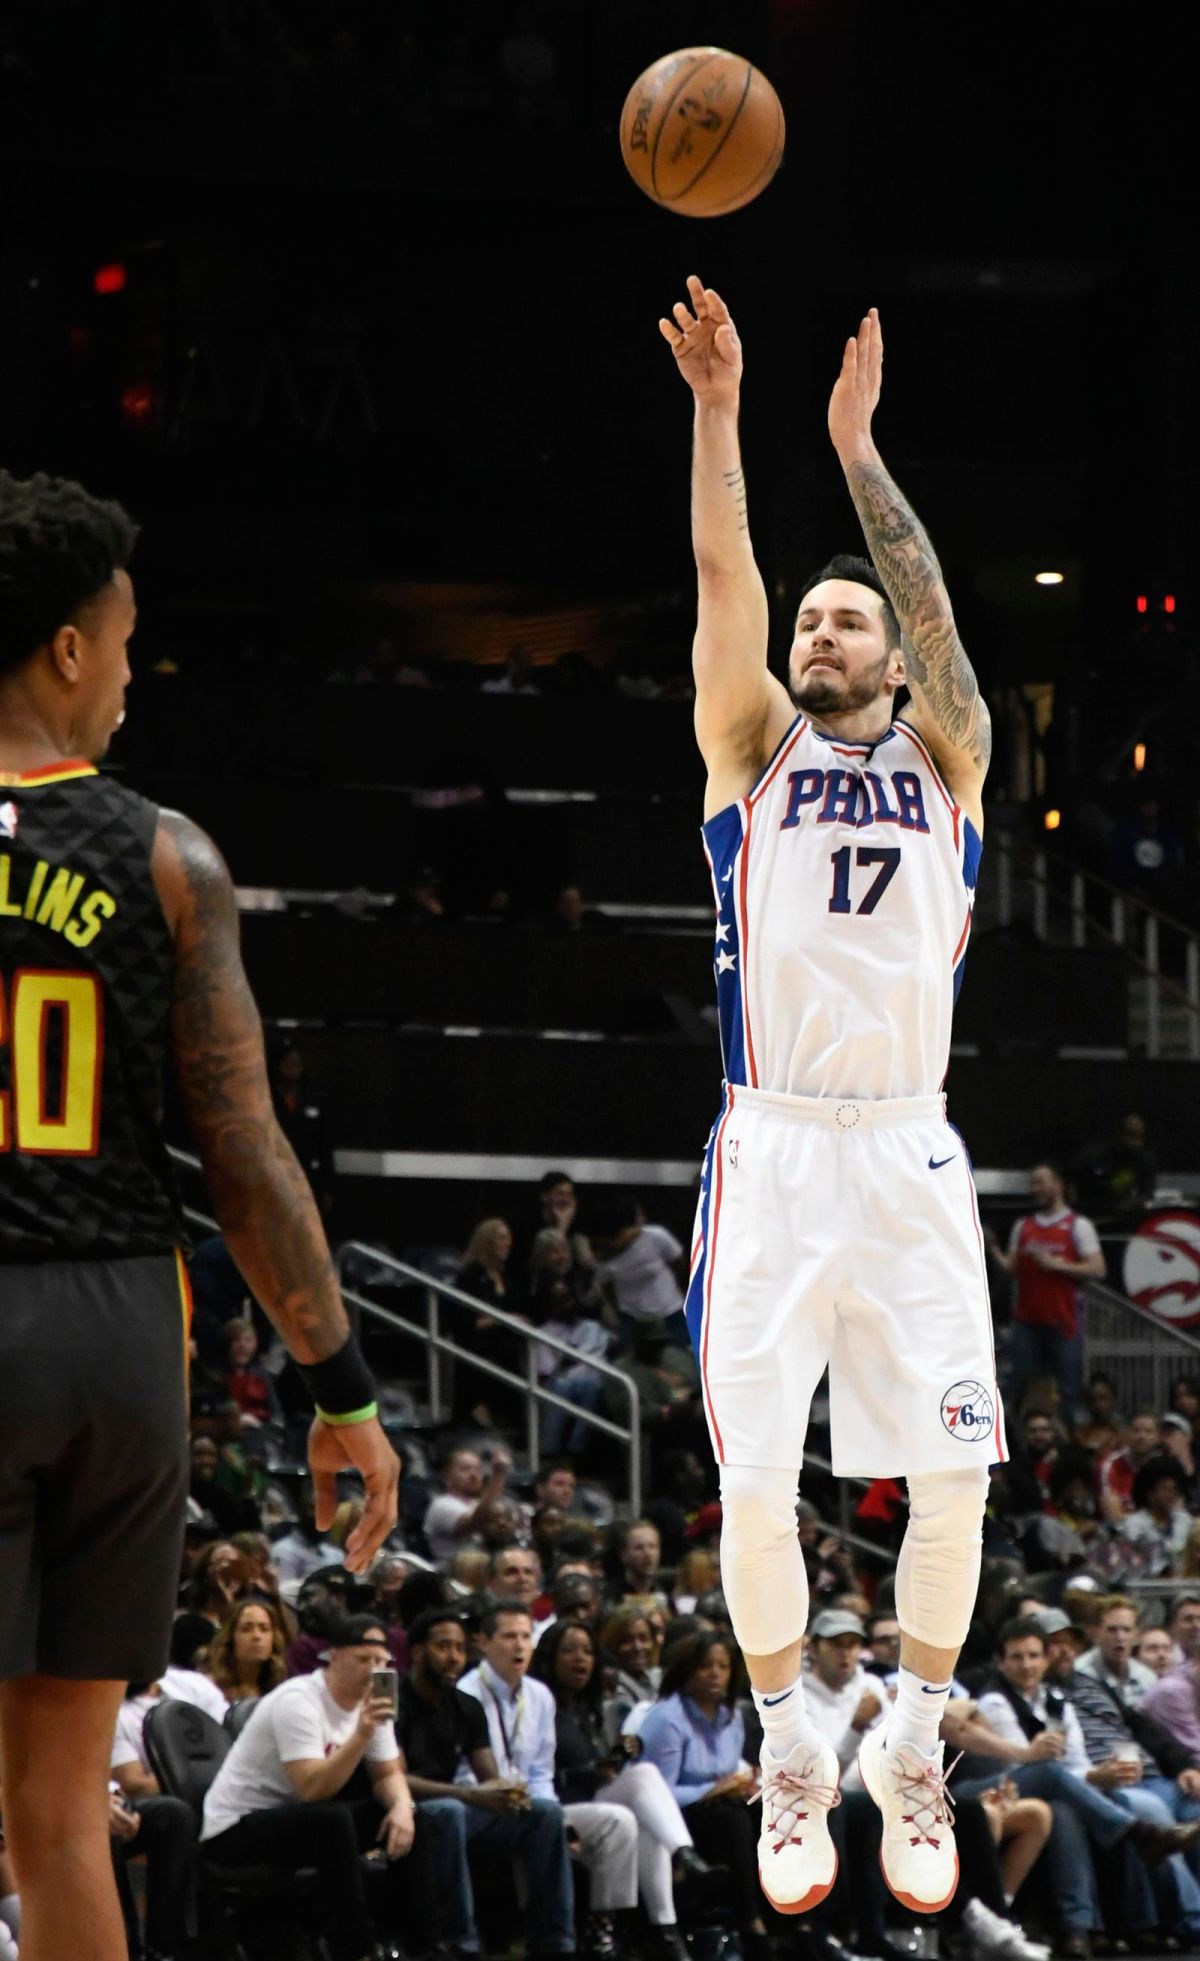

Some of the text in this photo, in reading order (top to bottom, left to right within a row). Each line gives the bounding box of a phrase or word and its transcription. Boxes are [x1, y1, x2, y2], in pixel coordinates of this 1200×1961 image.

[779, 768, 931, 835] PHILA
[0, 853, 117, 948] LINS
[828, 845, 902, 915] 17
[0, 967, 105, 1157] 0
